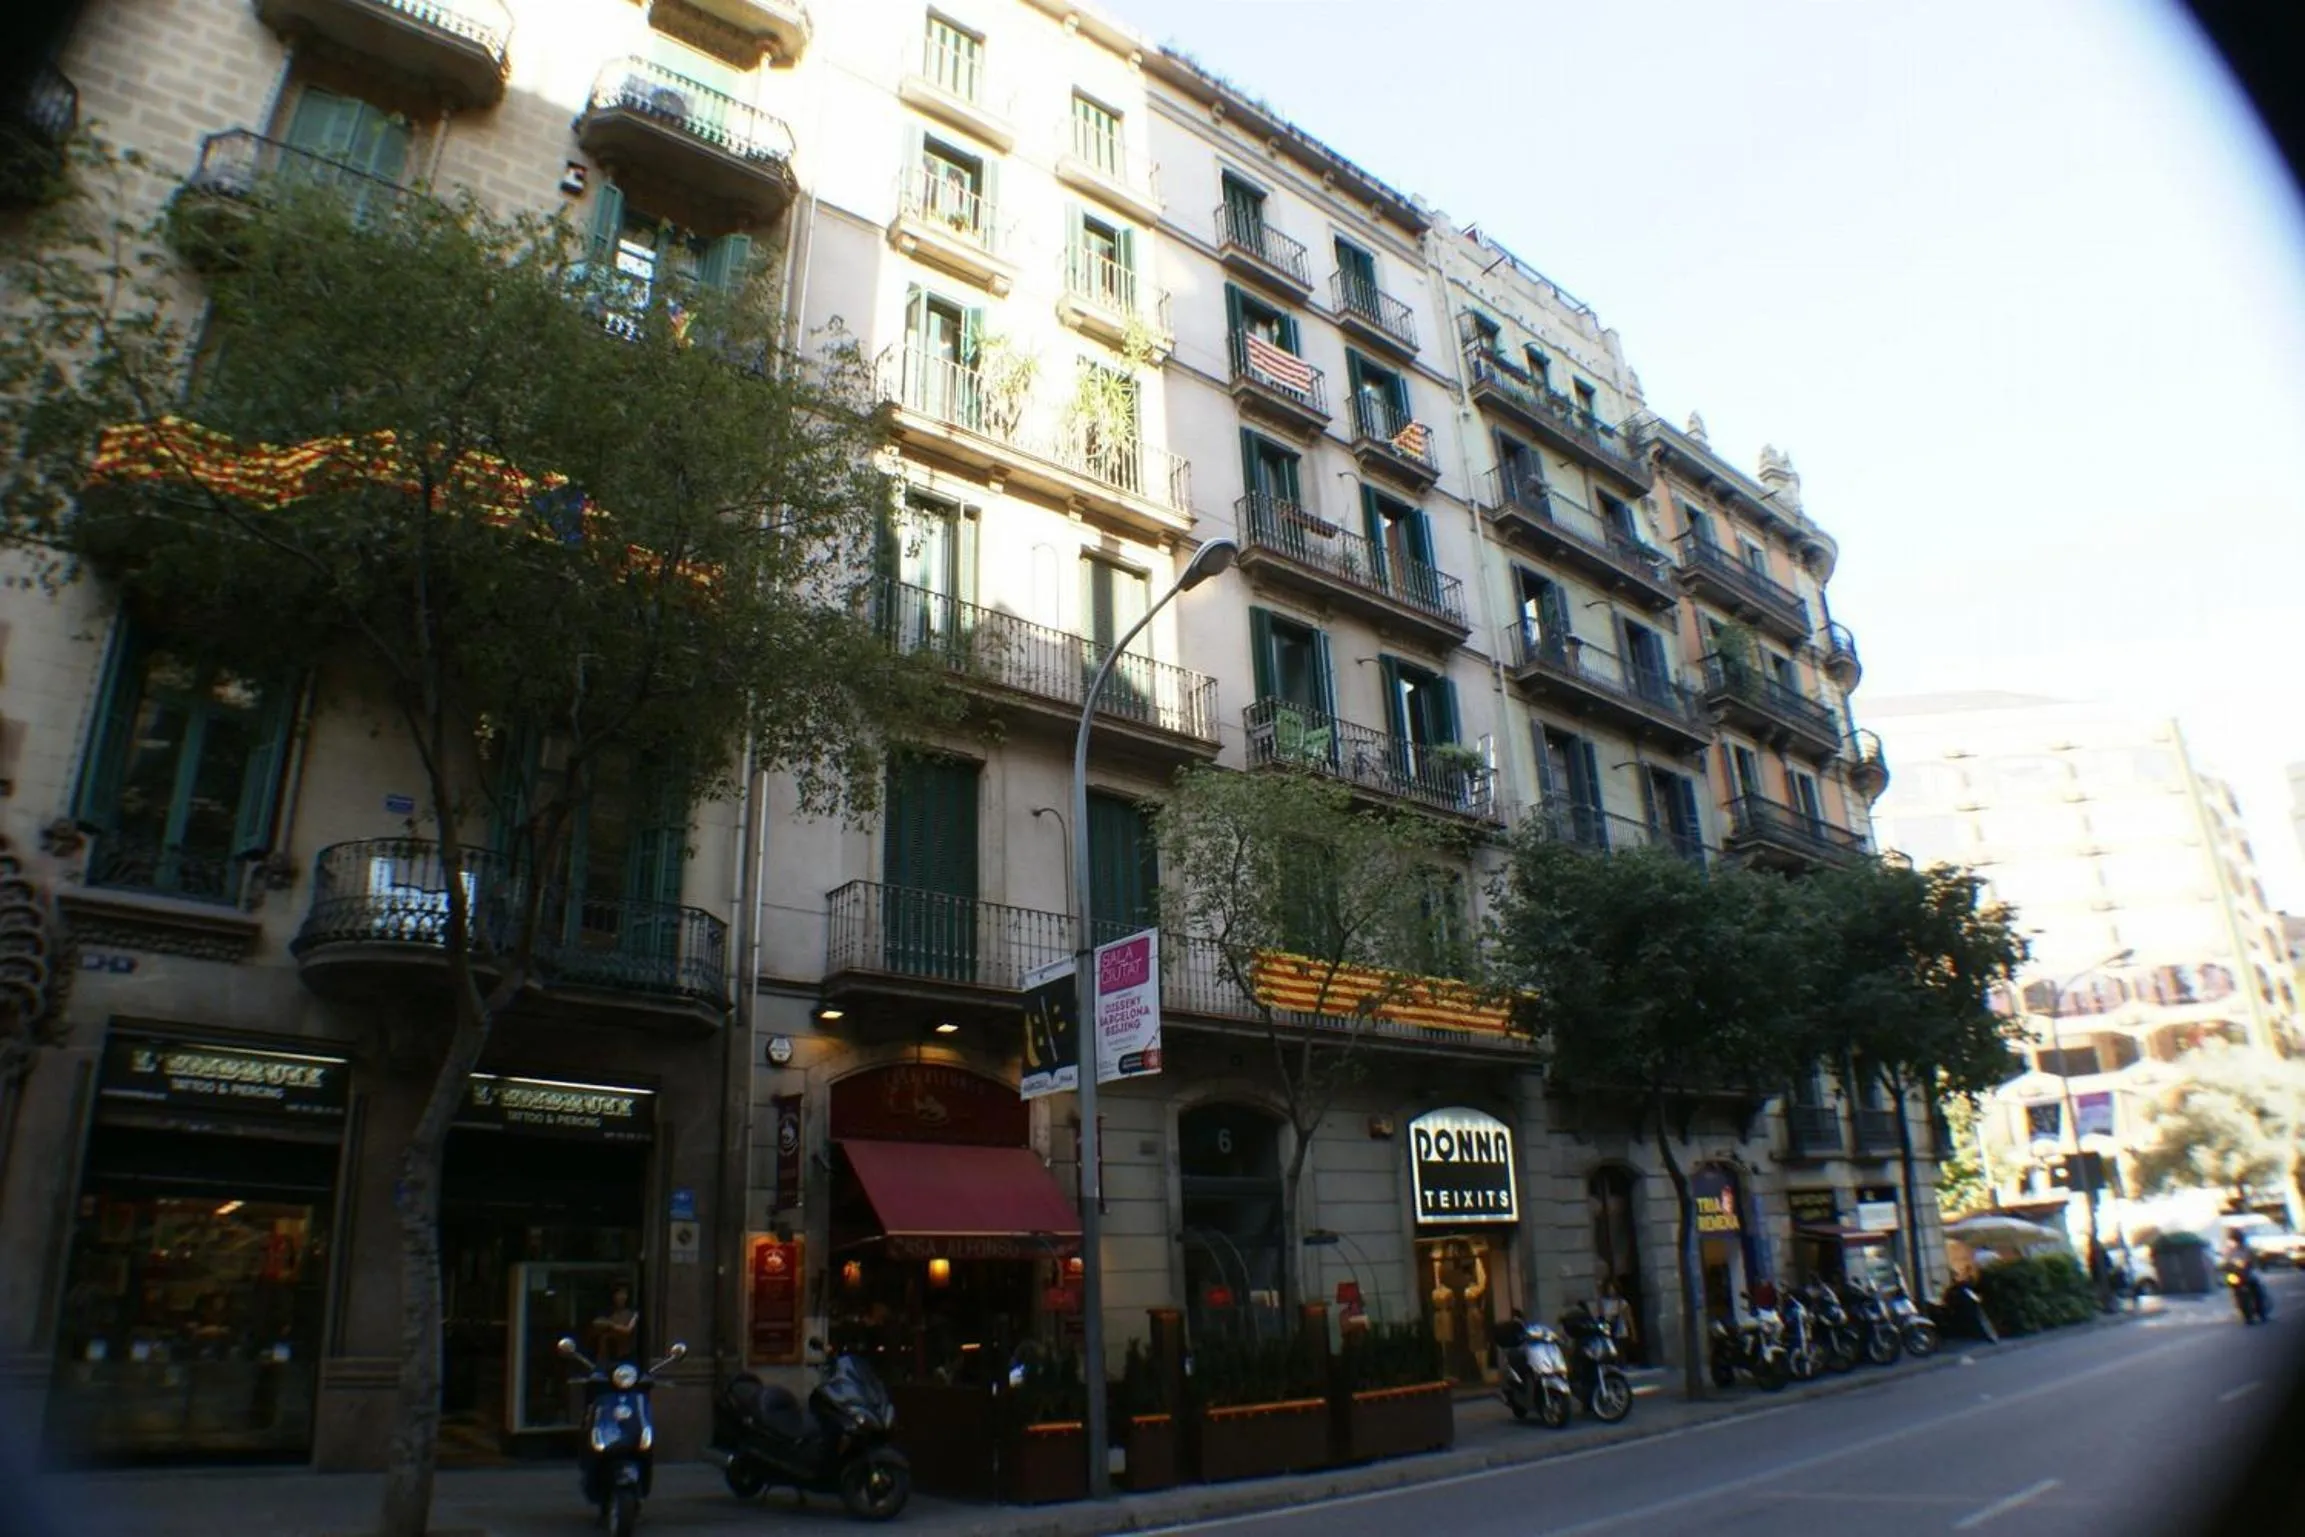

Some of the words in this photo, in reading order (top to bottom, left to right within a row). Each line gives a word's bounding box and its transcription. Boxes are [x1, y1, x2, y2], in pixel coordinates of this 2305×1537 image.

[1102, 946, 1134, 968] SALA
[1101, 958, 1142, 985] CIUTAT
[171, 1078, 214, 1094] TATTOO
[218, 1082, 229, 1095] &
[231, 1084, 284, 1100] PIERCING
[507, 1110, 544, 1123] TATTOO
[1218, 1128, 1232, 1153] 6
[1414, 1128, 1507, 1162] DONNA
[1424, 1190, 1509, 1208] TEIXITS
